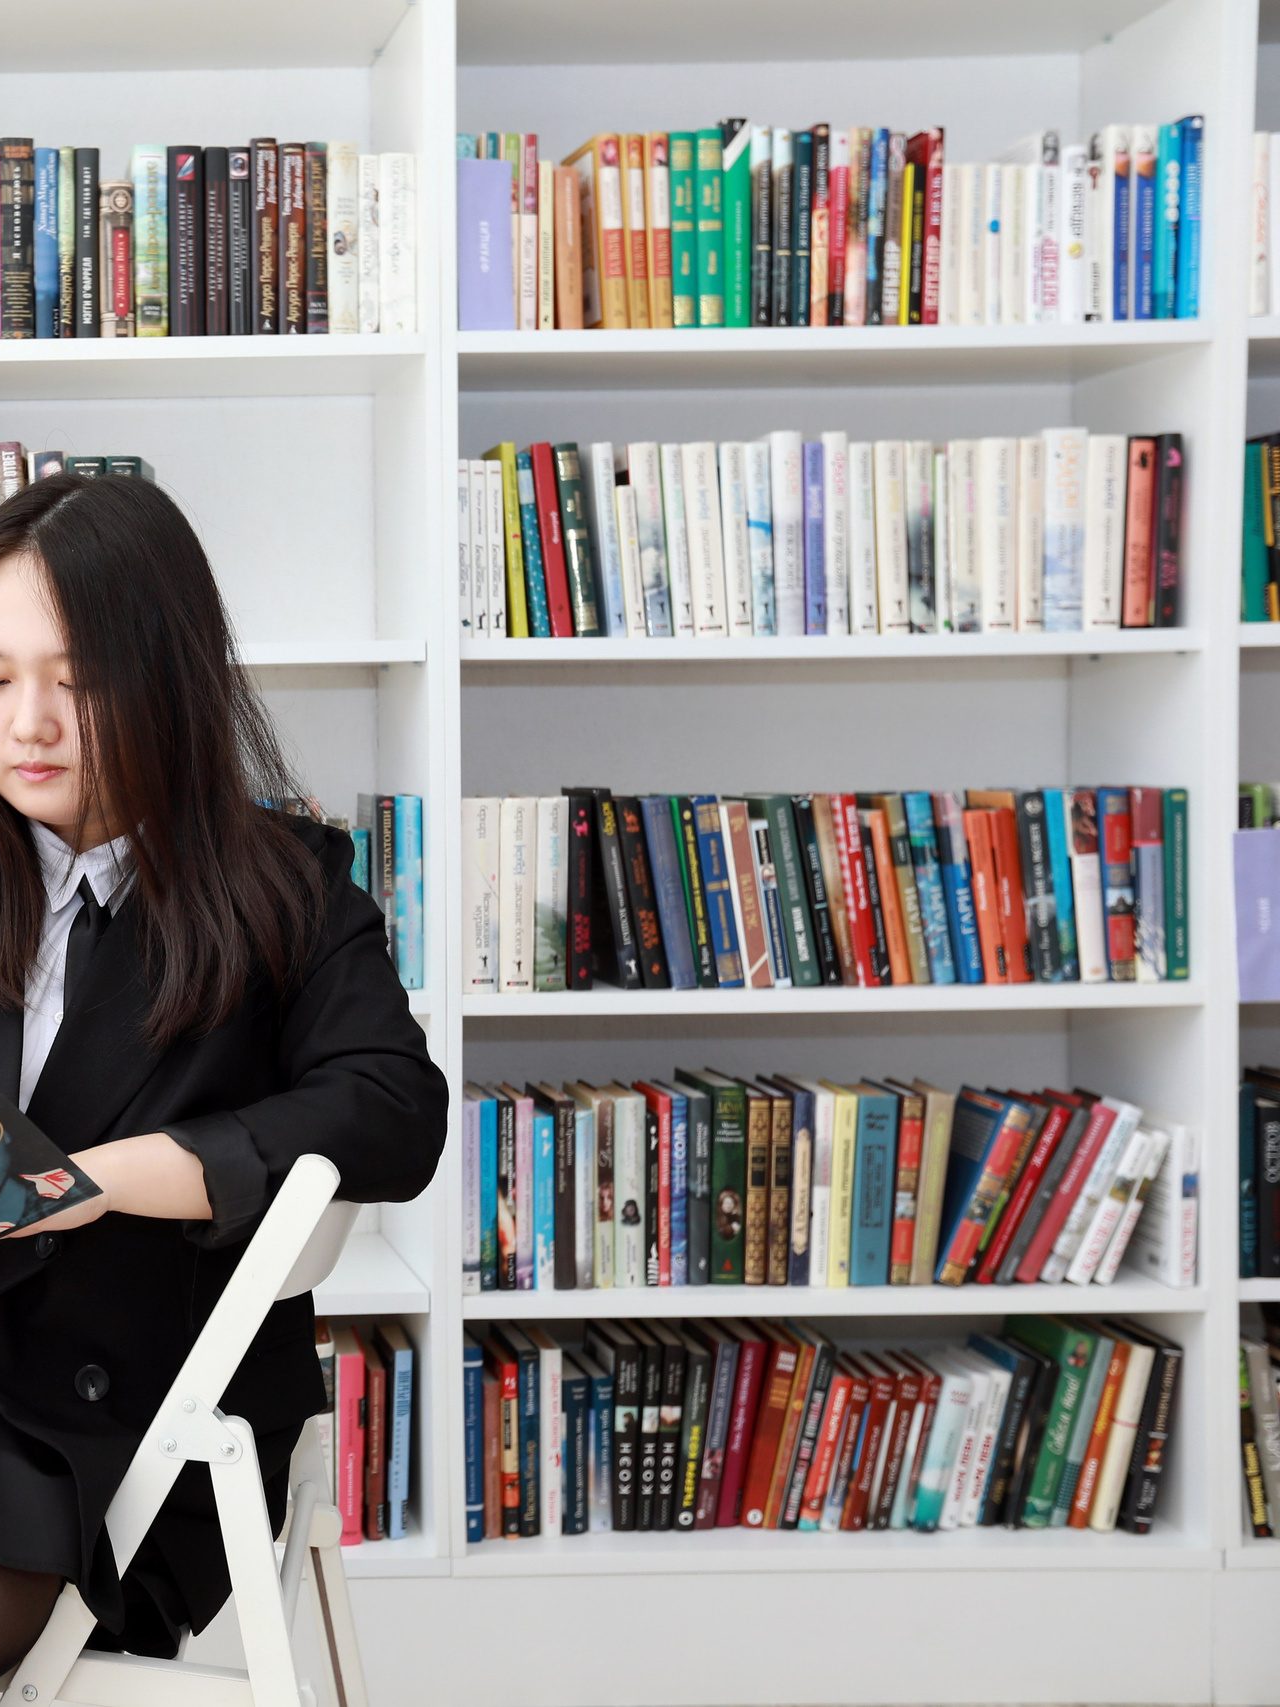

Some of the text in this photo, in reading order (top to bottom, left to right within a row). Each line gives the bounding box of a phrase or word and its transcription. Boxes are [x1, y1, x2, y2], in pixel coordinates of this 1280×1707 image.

[82, 302, 92, 324] МЭГГИ
[261, 284, 274, 316] Артуро
[287, 289, 300, 322] Артуро
[2, 451, 17, 477] ОТВЕТ
[383, 810, 393, 890] ДЕГУСТАТОРШИ
[904, 887, 922, 933] ГАРИ
[929, 885, 947, 932] ГАРИ
[956, 888, 974, 935] ГАРИ
[674, 1123, 686, 1160] СОЛЬ
[688, 1426, 700, 1459] КОЭН
[619, 1443, 632, 1495] КОЭН
[642, 1443, 655, 1495] КОЭН
[660, 1443, 674, 1495] КОЭН
